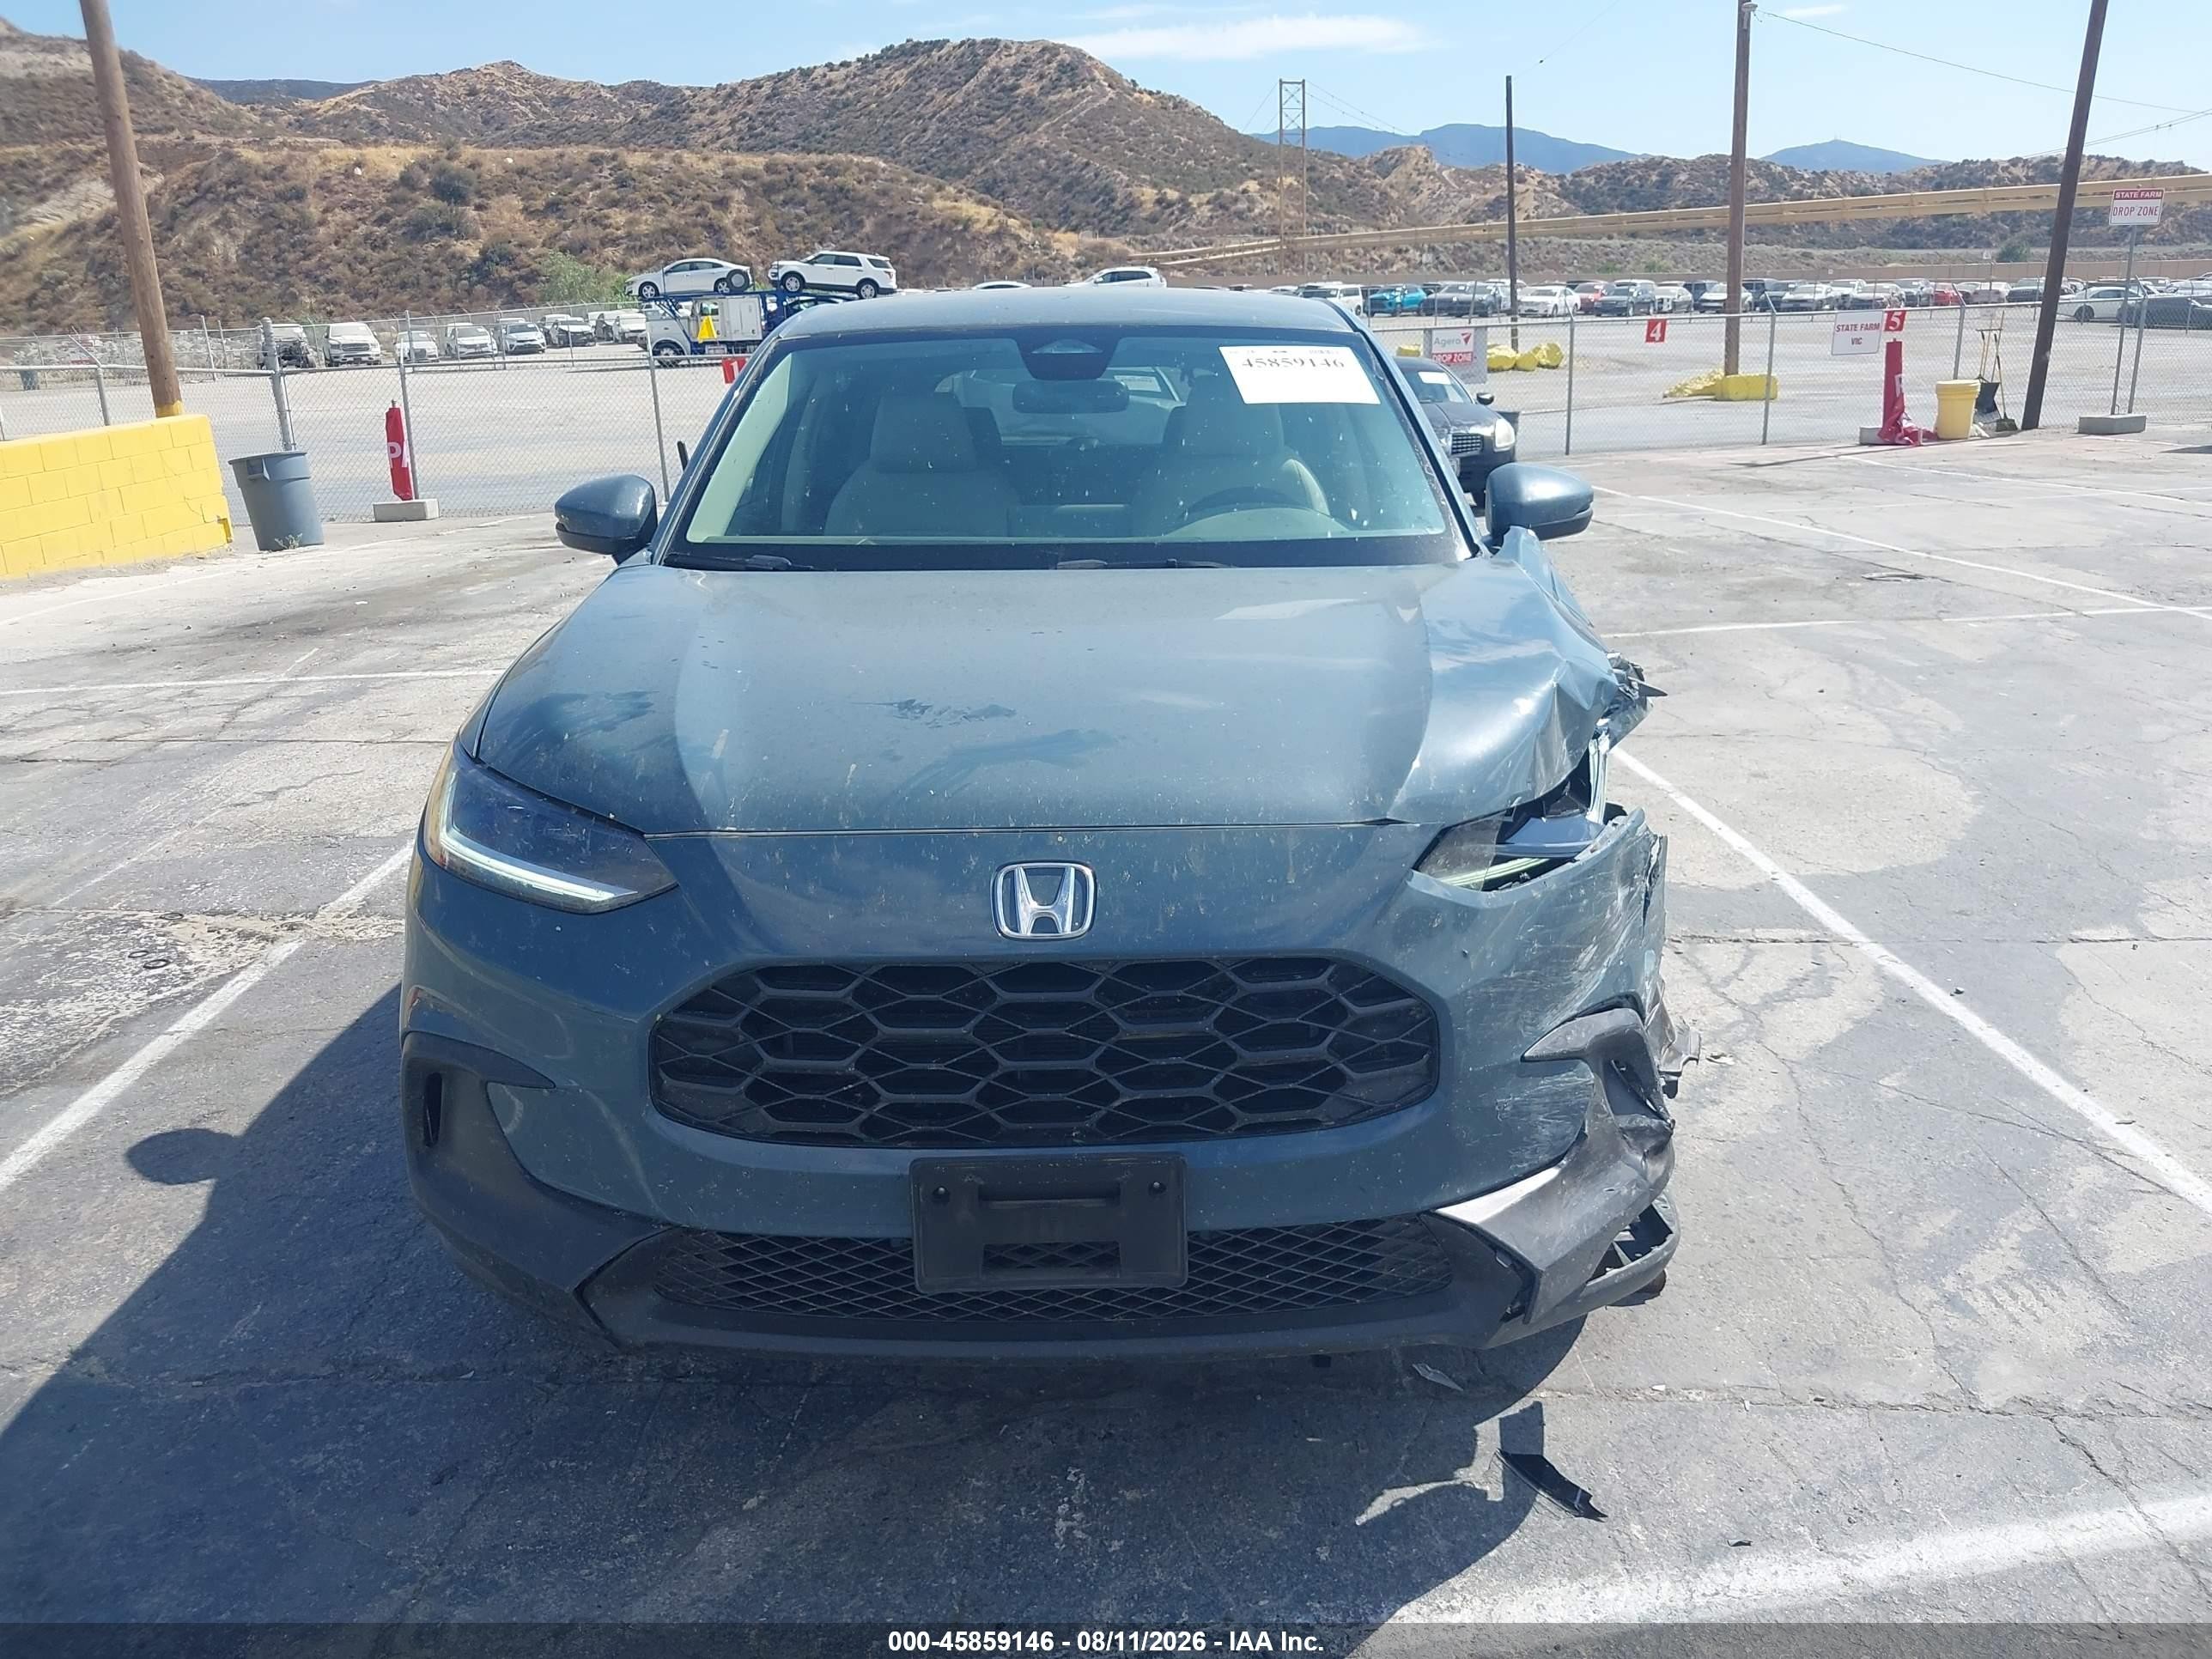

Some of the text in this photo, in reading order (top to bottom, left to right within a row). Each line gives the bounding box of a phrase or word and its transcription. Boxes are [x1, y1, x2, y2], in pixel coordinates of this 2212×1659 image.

[2115, 190, 2162, 199] STATE FARM
[2112, 205, 2160, 216] DROP ZONE
[1888, 311, 1901, 330] 5
[1650, 322, 1662, 342] 4
[1836, 322, 1881, 332] STATE FARM
[1434, 337, 1462, 348] Agero
[1850, 337, 1863, 345] VIC
[1242, 357, 1346, 368] 45859146
[1432, 353, 1453, 362] DROP
[730, 361, 739, 380] 1
